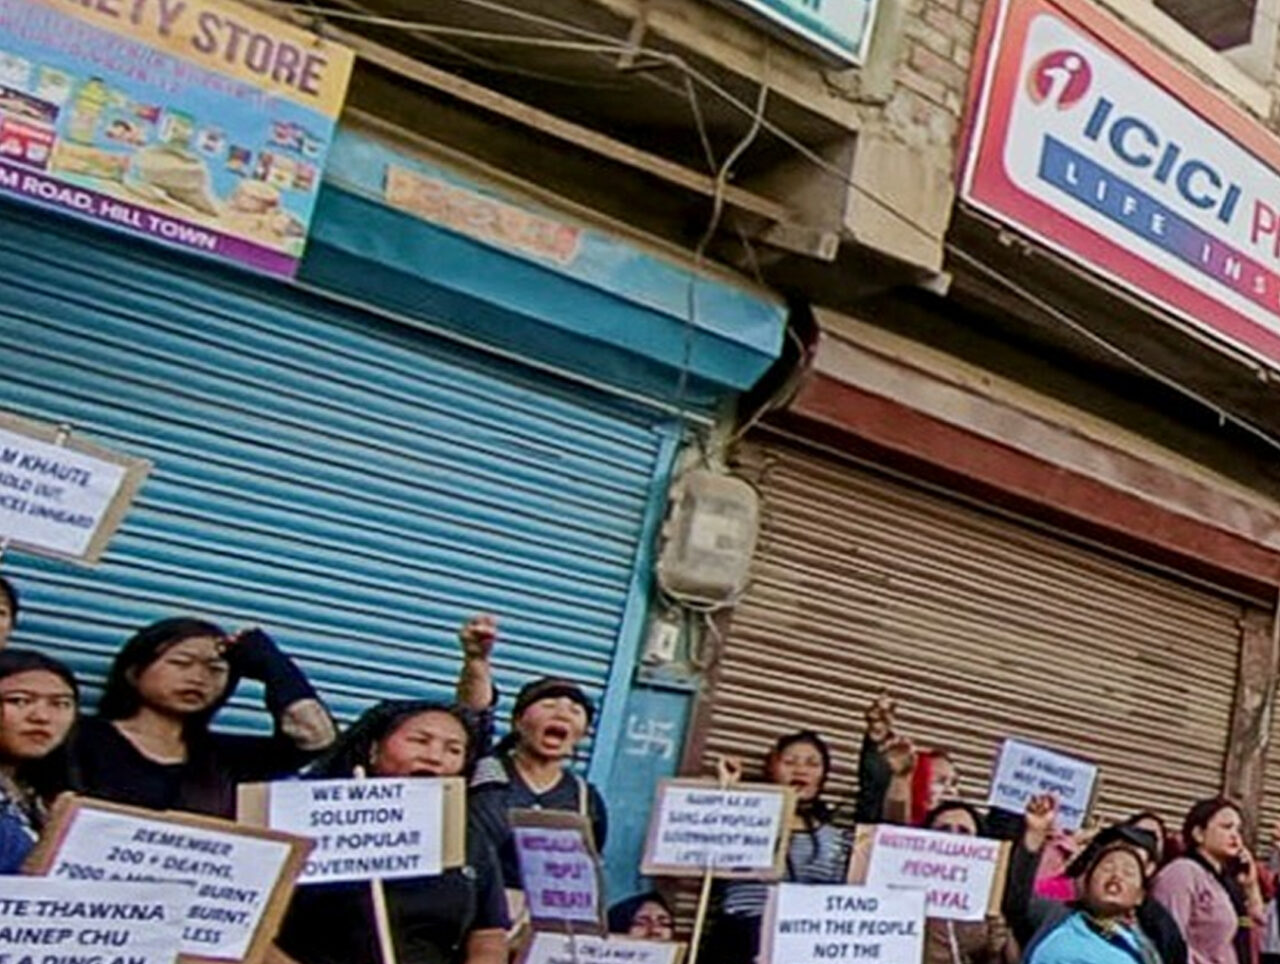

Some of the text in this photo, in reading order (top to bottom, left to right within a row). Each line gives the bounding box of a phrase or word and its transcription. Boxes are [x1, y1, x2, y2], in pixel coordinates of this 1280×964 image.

[191, 11, 329, 97] STORE
[1084, 96, 1243, 225] ICICI
[1066, 161, 1167, 236] LIFE
[22, 175, 97, 214] ROAD,
[100, 200, 145, 227] HILL
[149, 215, 219, 250] TOWN
[18, 454, 91, 487] KHAUTE
[312, 784, 402, 801] WE WANT
[310, 808, 403, 827] SOLUTION
[132, 828, 233, 857] REMEMBER
[335, 831, 420, 849] POPULAR
[107, 847, 144, 864] 200
[36, 900, 165, 921] THAWKNA
[826, 895, 879, 912] STAND
[779, 919, 821, 935] WITH
[826, 919, 854, 935] THE
[77, 928, 129, 947] CHU
[813, 944, 881, 959] NOT THE
